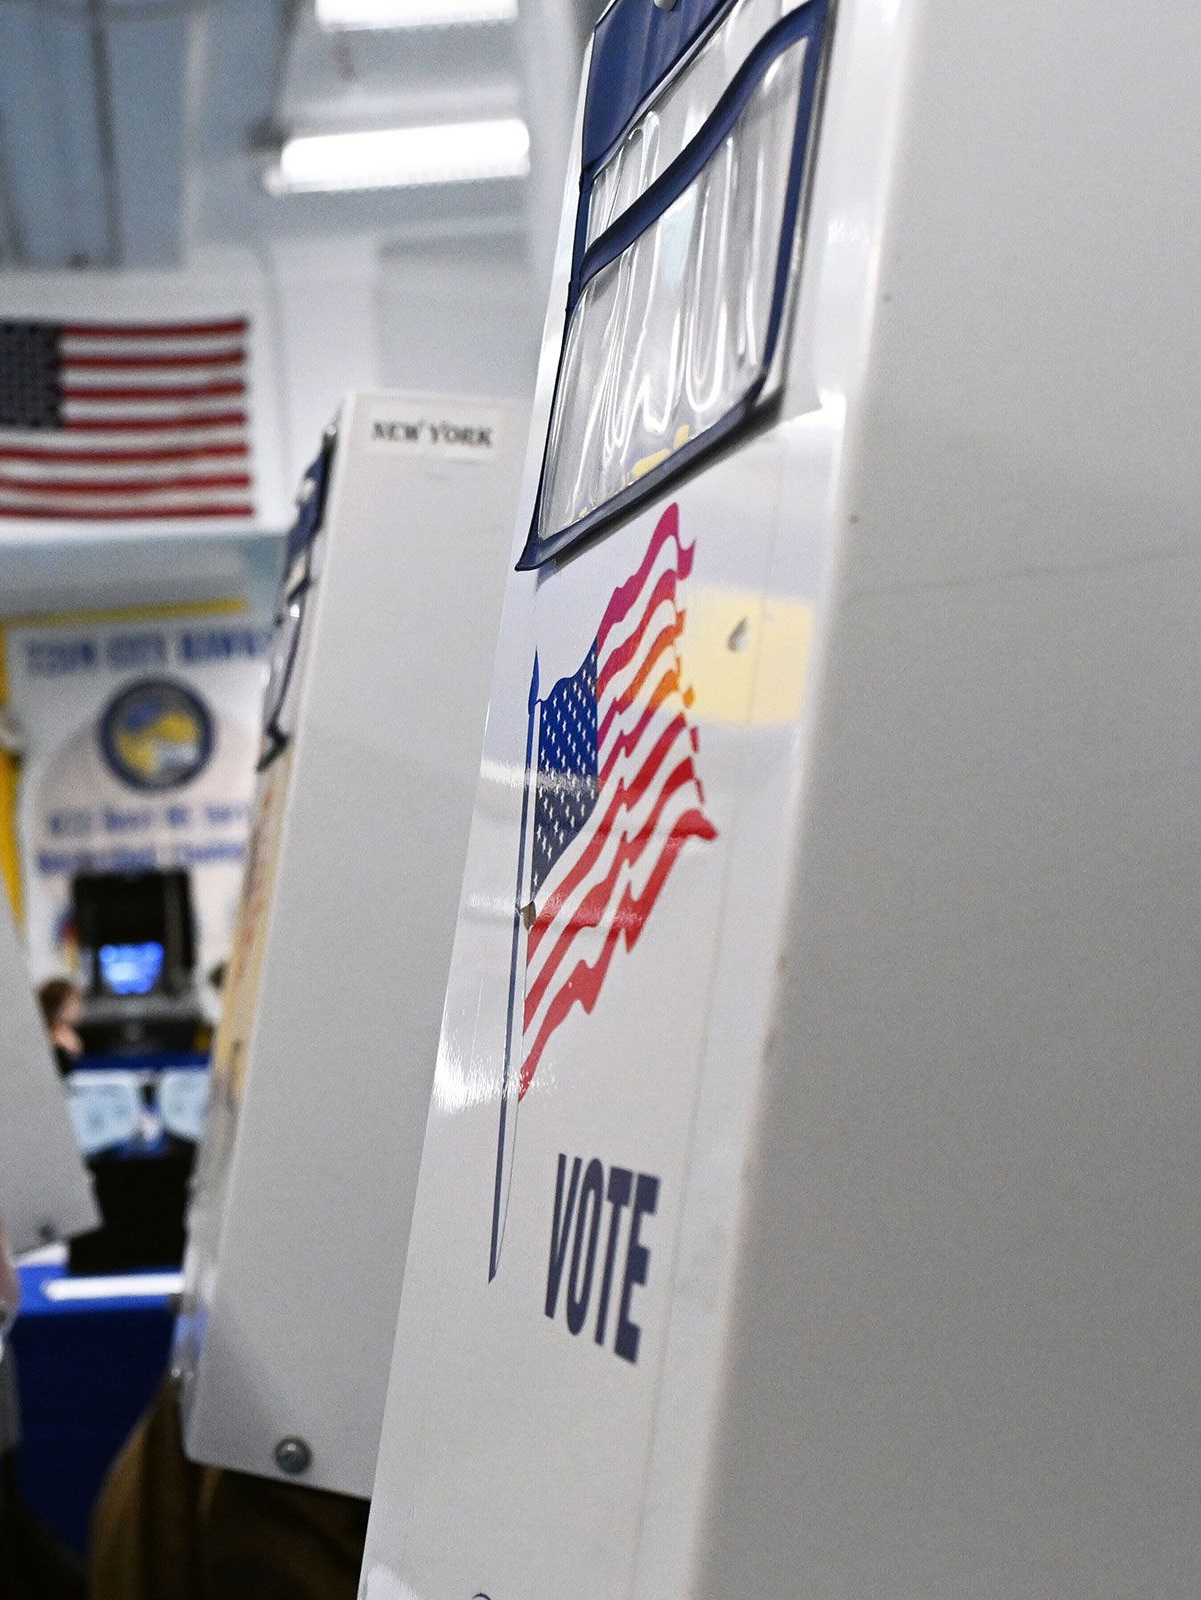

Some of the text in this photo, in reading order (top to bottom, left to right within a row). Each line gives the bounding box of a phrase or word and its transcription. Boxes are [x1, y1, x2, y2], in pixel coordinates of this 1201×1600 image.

[372, 419, 492, 447] NEW YORK
[545, 1153, 660, 1366] VOTE
